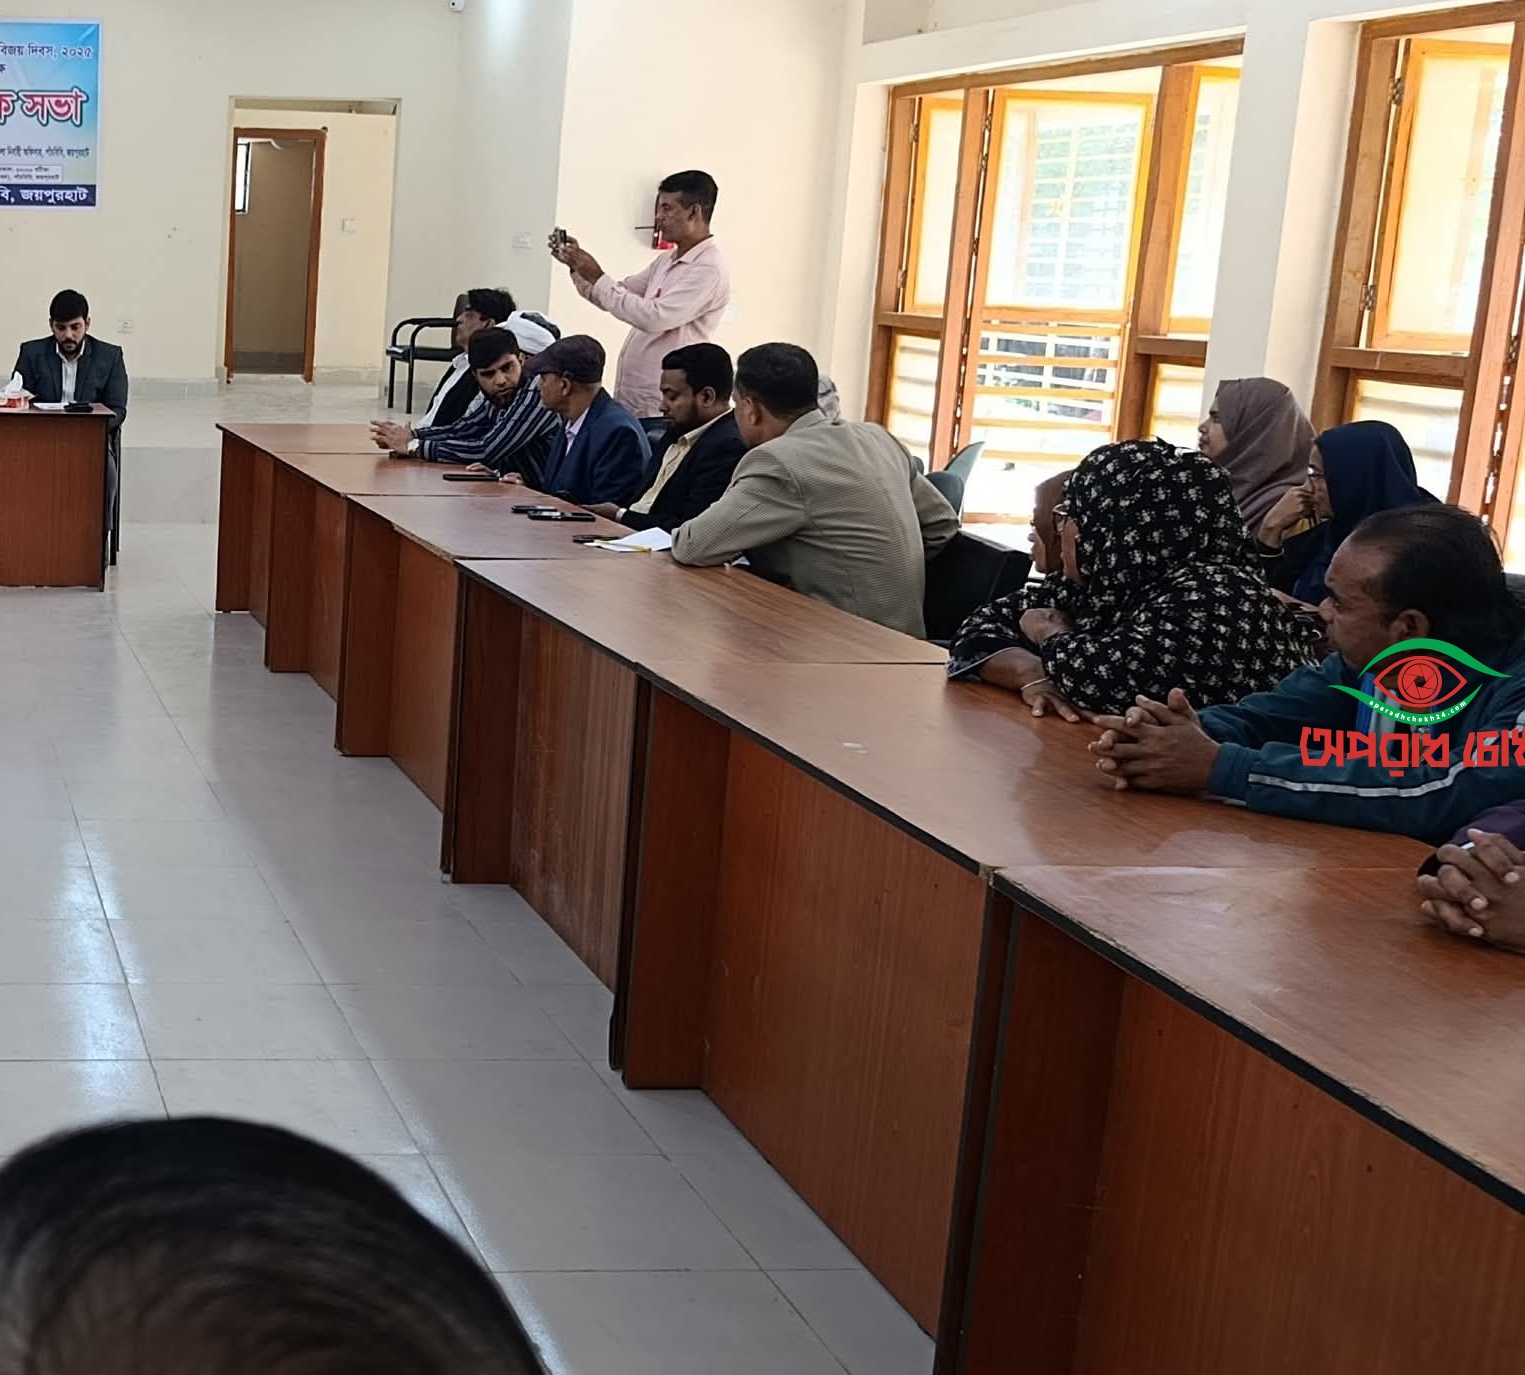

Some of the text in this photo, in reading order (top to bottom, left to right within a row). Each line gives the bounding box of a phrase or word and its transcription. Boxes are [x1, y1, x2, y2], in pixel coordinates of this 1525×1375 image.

[61, 46, 92, 58] ২০২৫
[20, 85, 88, 126] সভা
[20, 186, 89, 204] জয়পুরহাট
